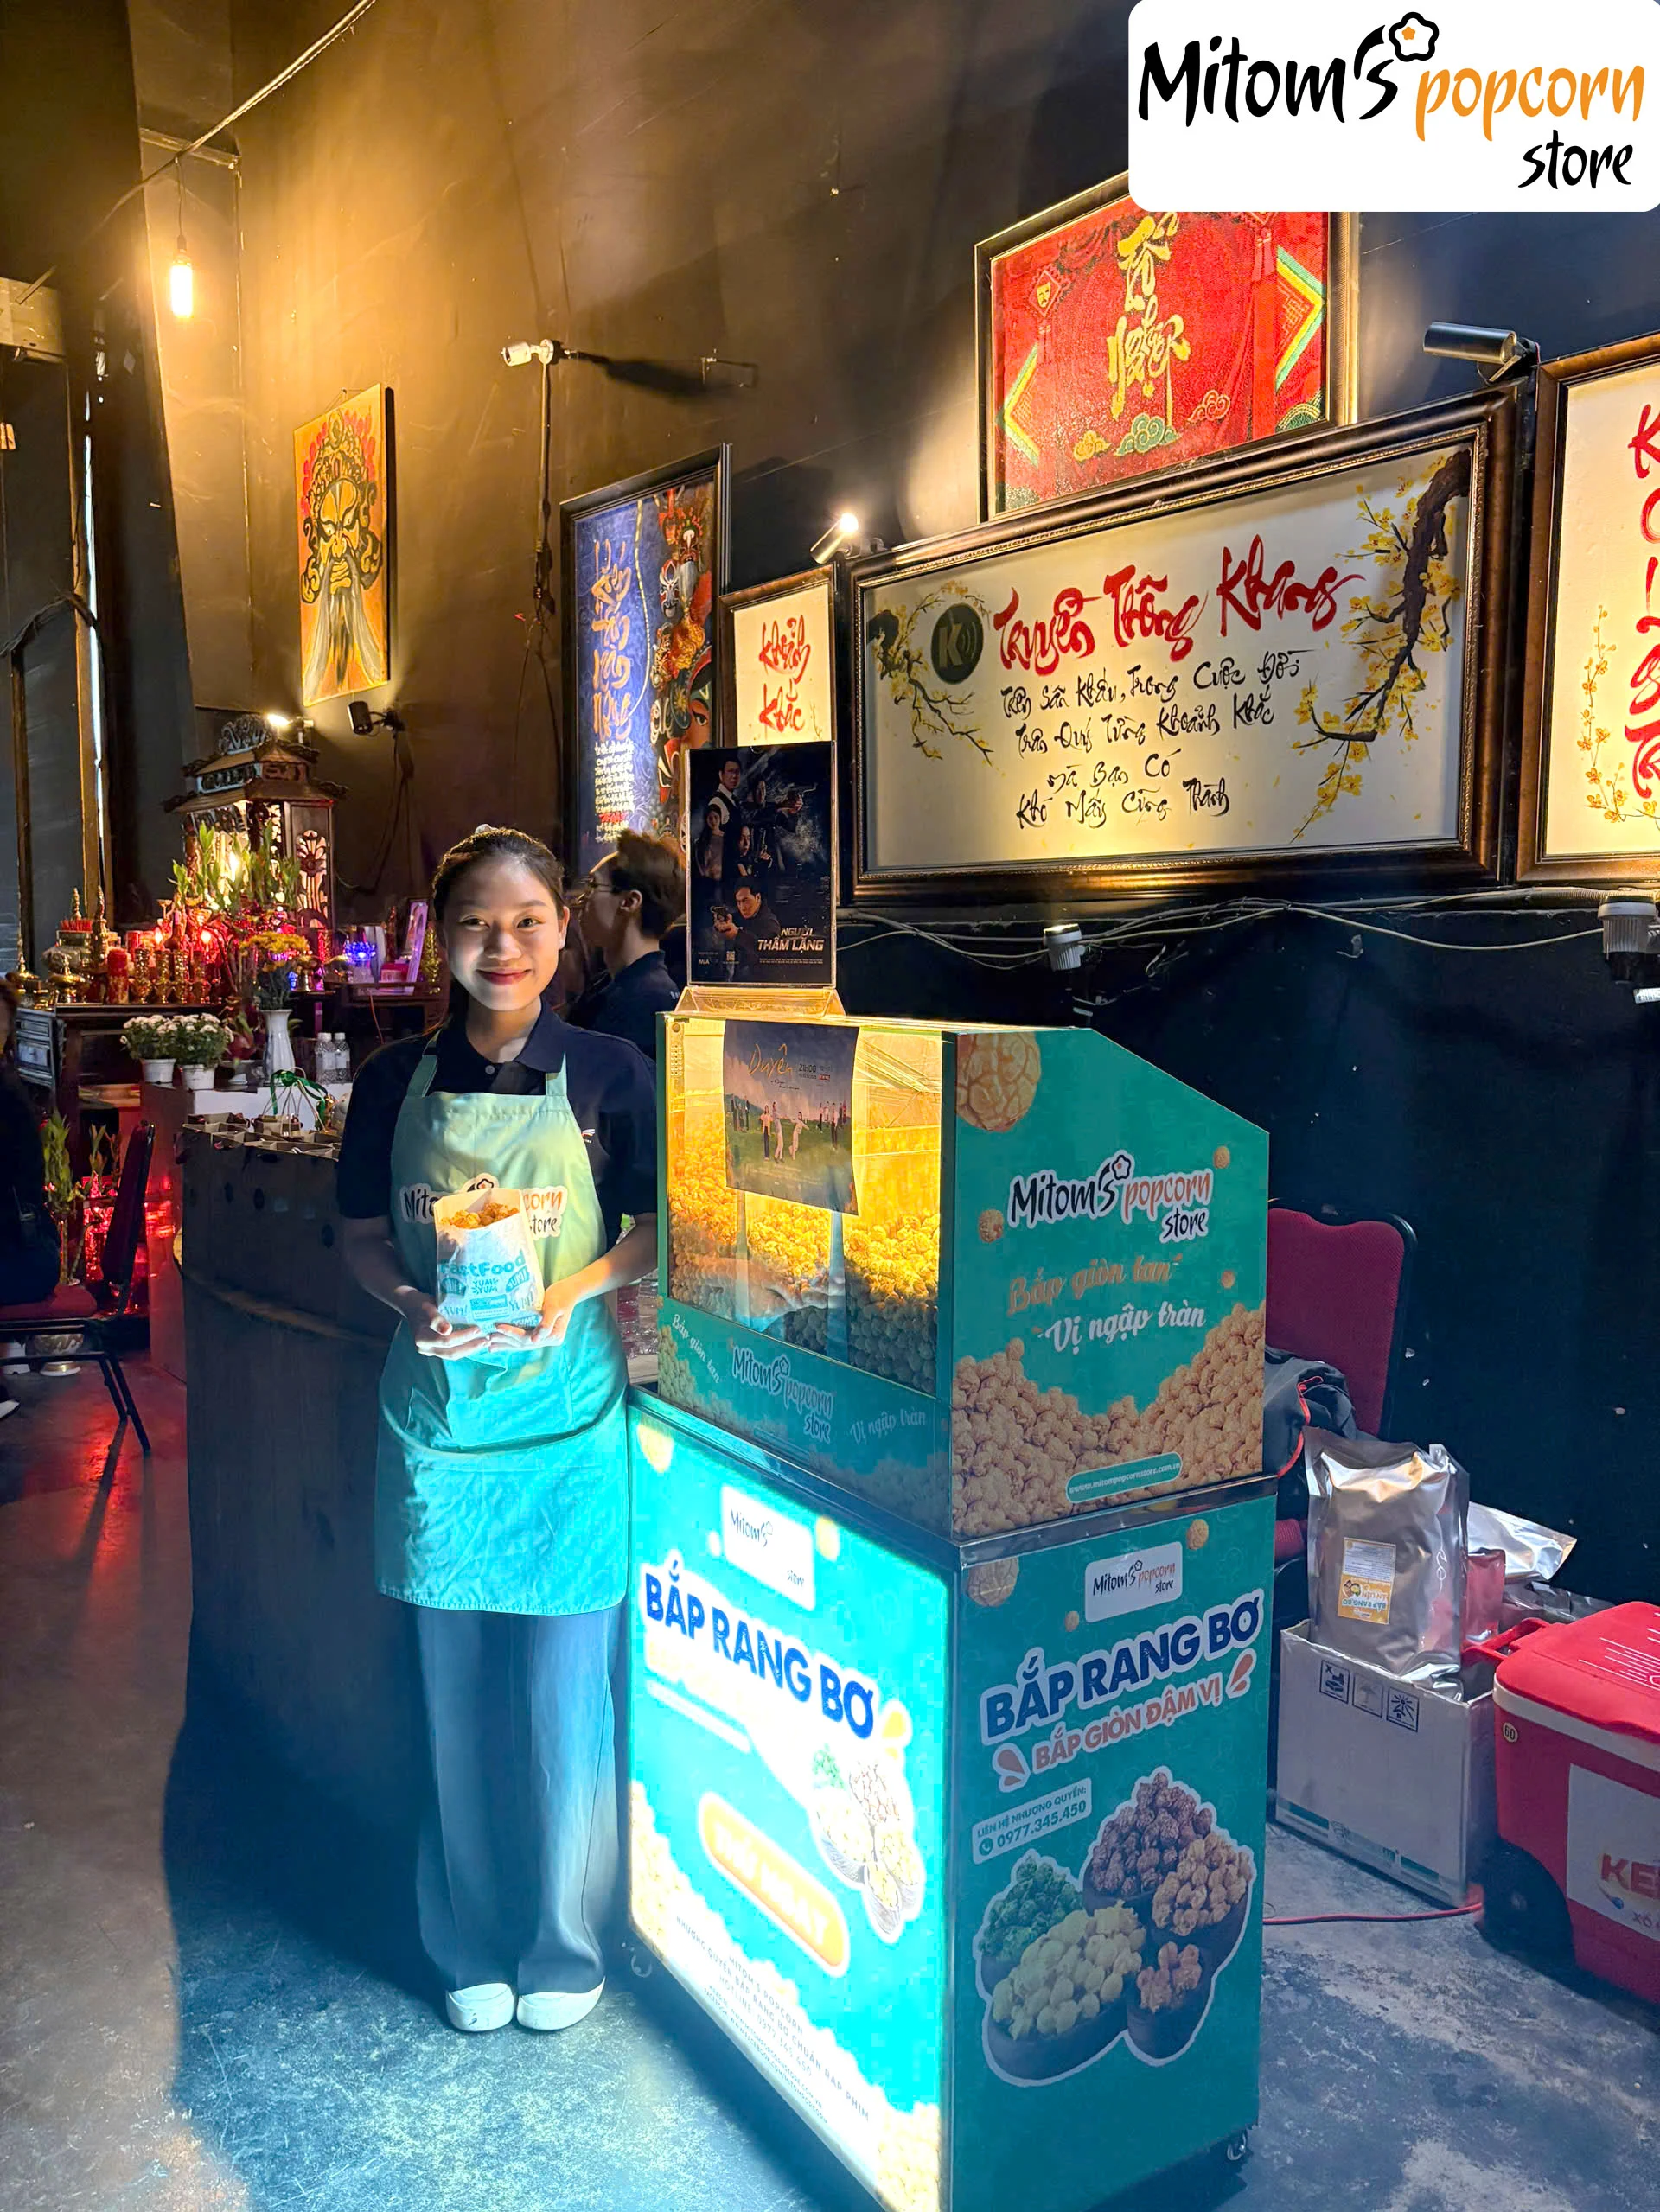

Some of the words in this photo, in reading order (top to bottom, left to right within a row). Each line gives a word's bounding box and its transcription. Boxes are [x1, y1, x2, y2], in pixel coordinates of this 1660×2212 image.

[1217, 534, 1366, 637] Khang
[1193, 657, 1246, 691] Cuộc
[1090, 761, 1128, 787] Bạn
[1145, 748, 1181, 778] Có
[1183, 777, 1230, 817] Thành
[523, 1190, 562, 1210] corn
[1124, 1170, 1210, 1221] popcorn
[1163, 1208, 1206, 1239] store
[1006, 1267, 1066, 1317] Bắp
[1072, 1259, 1126, 1299] giòn
[1045, 1316, 1082, 1355] Vị
[1089, 1303, 1152, 1344] ngập
[1158, 1300, 1205, 1328] tràn
[784, 1380, 833, 1418] popcorn
[805, 1413, 830, 1442] store
[1137, 1562, 1176, 1587] popcorn
[1155, 1578, 1174, 1594] store
[646, 1560, 705, 1639] BẮP
[712, 1606, 811, 1702] RANG
[820, 1664, 874, 1739] BƠ
[986, 1655, 1074, 1739] BẮP
[1082, 1623, 1201, 1702] RANG
[1209, 1596, 1260, 1654] BƠ
[1035, 1728, 1081, 1770] BẮP
[1085, 1706, 1141, 1749] GIÒN
[1146, 1689, 1196, 1725] ĐẬM
[1197, 1676, 1222, 1707] VỊ
[977, 1824, 997, 1839] LIÊN
[997, 1799, 1087, 1848] 0977.345.450
[1601, 1852, 1660, 1900] KE
